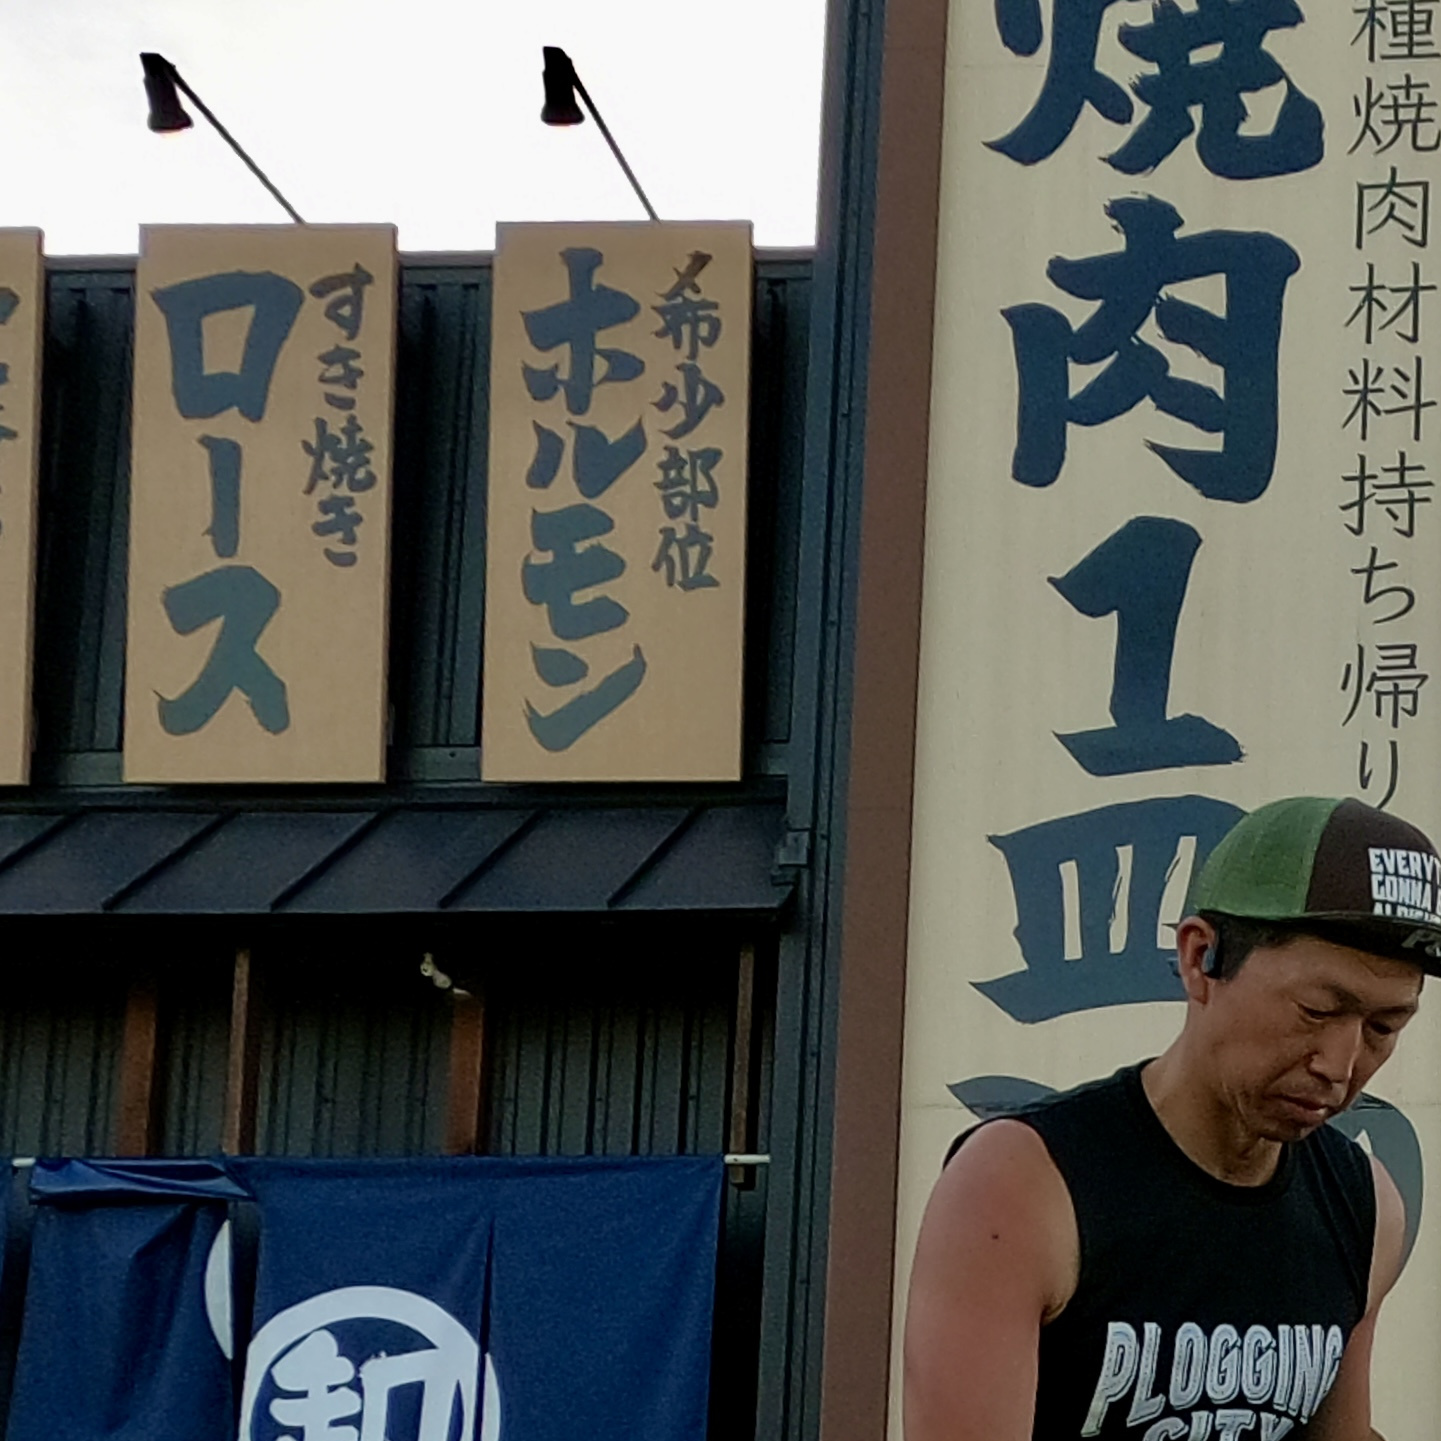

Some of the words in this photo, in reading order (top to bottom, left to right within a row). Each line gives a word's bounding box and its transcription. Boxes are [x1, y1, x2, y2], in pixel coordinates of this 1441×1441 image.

[151, 270, 305, 736] ロース
[302, 262, 377, 567] すき焼き
[520, 246, 647, 752] ホルモン
[651, 250, 726, 592] 希少部位
[1371, 874, 1432, 913] GONNA
[1080, 1321, 1344, 1438] PLOGGING
